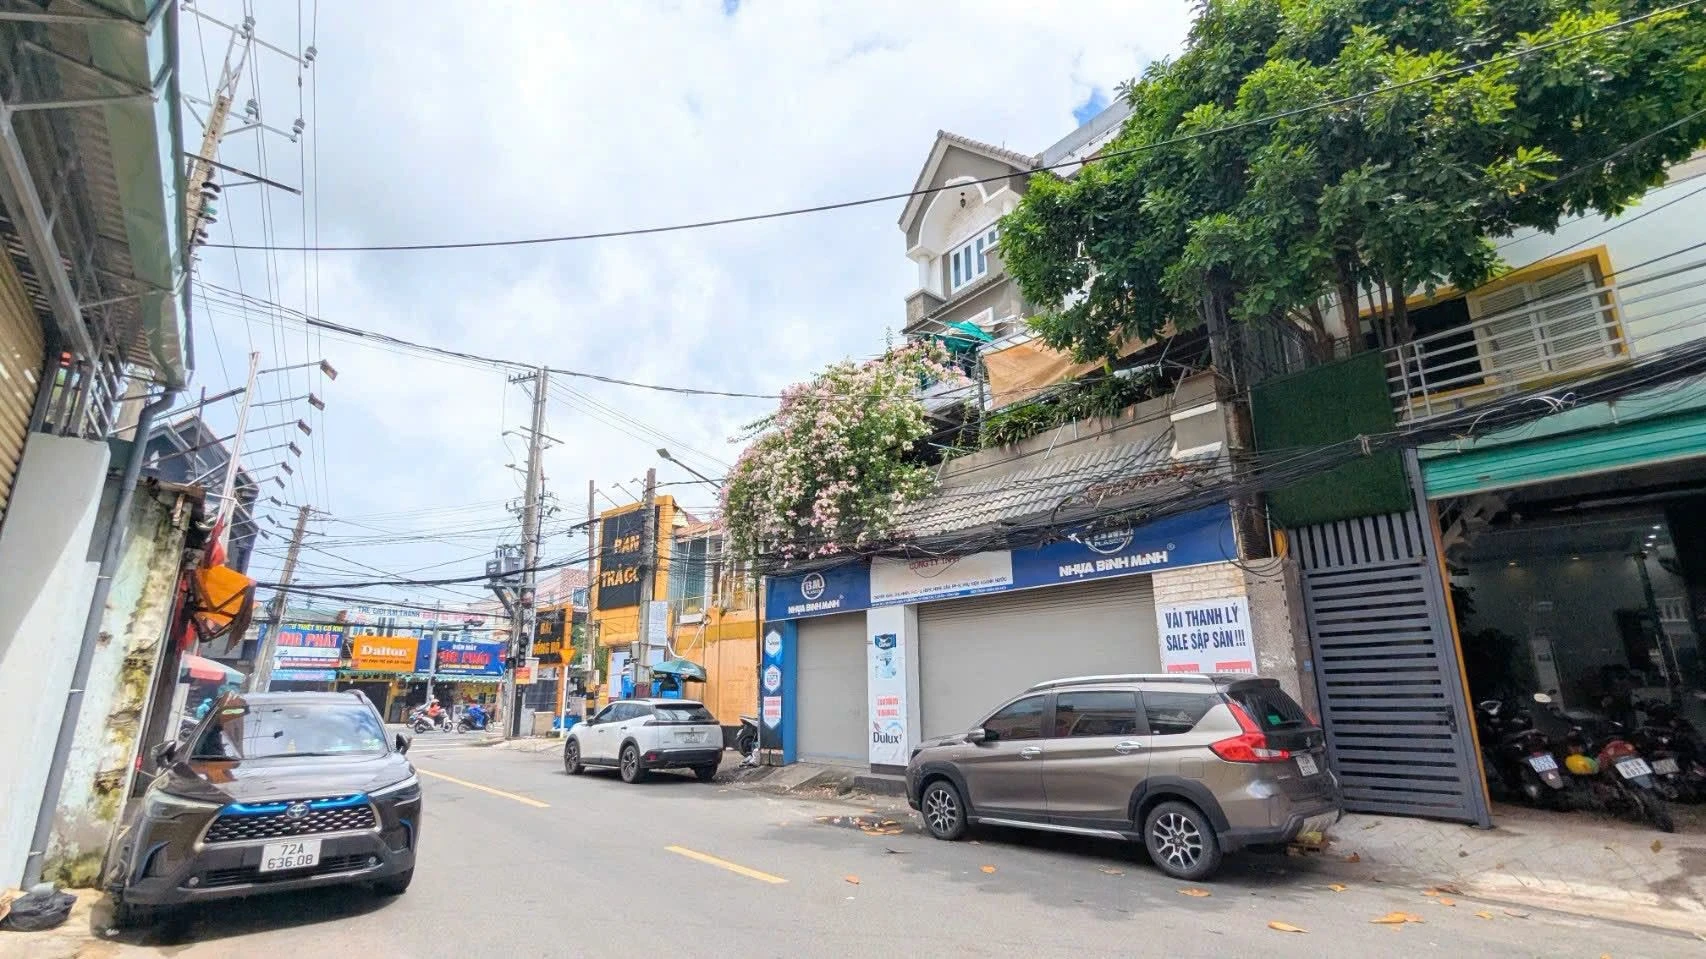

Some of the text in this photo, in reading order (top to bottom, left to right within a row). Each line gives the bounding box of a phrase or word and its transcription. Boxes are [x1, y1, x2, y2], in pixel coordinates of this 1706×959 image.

[1059, 562, 1095, 577] NHỰA
[788, 604, 806, 615] NHỰA
[1185, 608, 1223, 627] THANH
[1225, 602, 1238, 624] LÝ
[304, 632, 339, 647] PHÁT
[1166, 634, 1189, 651] SALE
[1191, 629, 1210, 653] SẬP
[360, 645, 407, 656] Dalton
[873, 732, 899, 743] Dulux
[281, 844, 304, 855] 72A
[267, 854, 313, 869] 636.08
